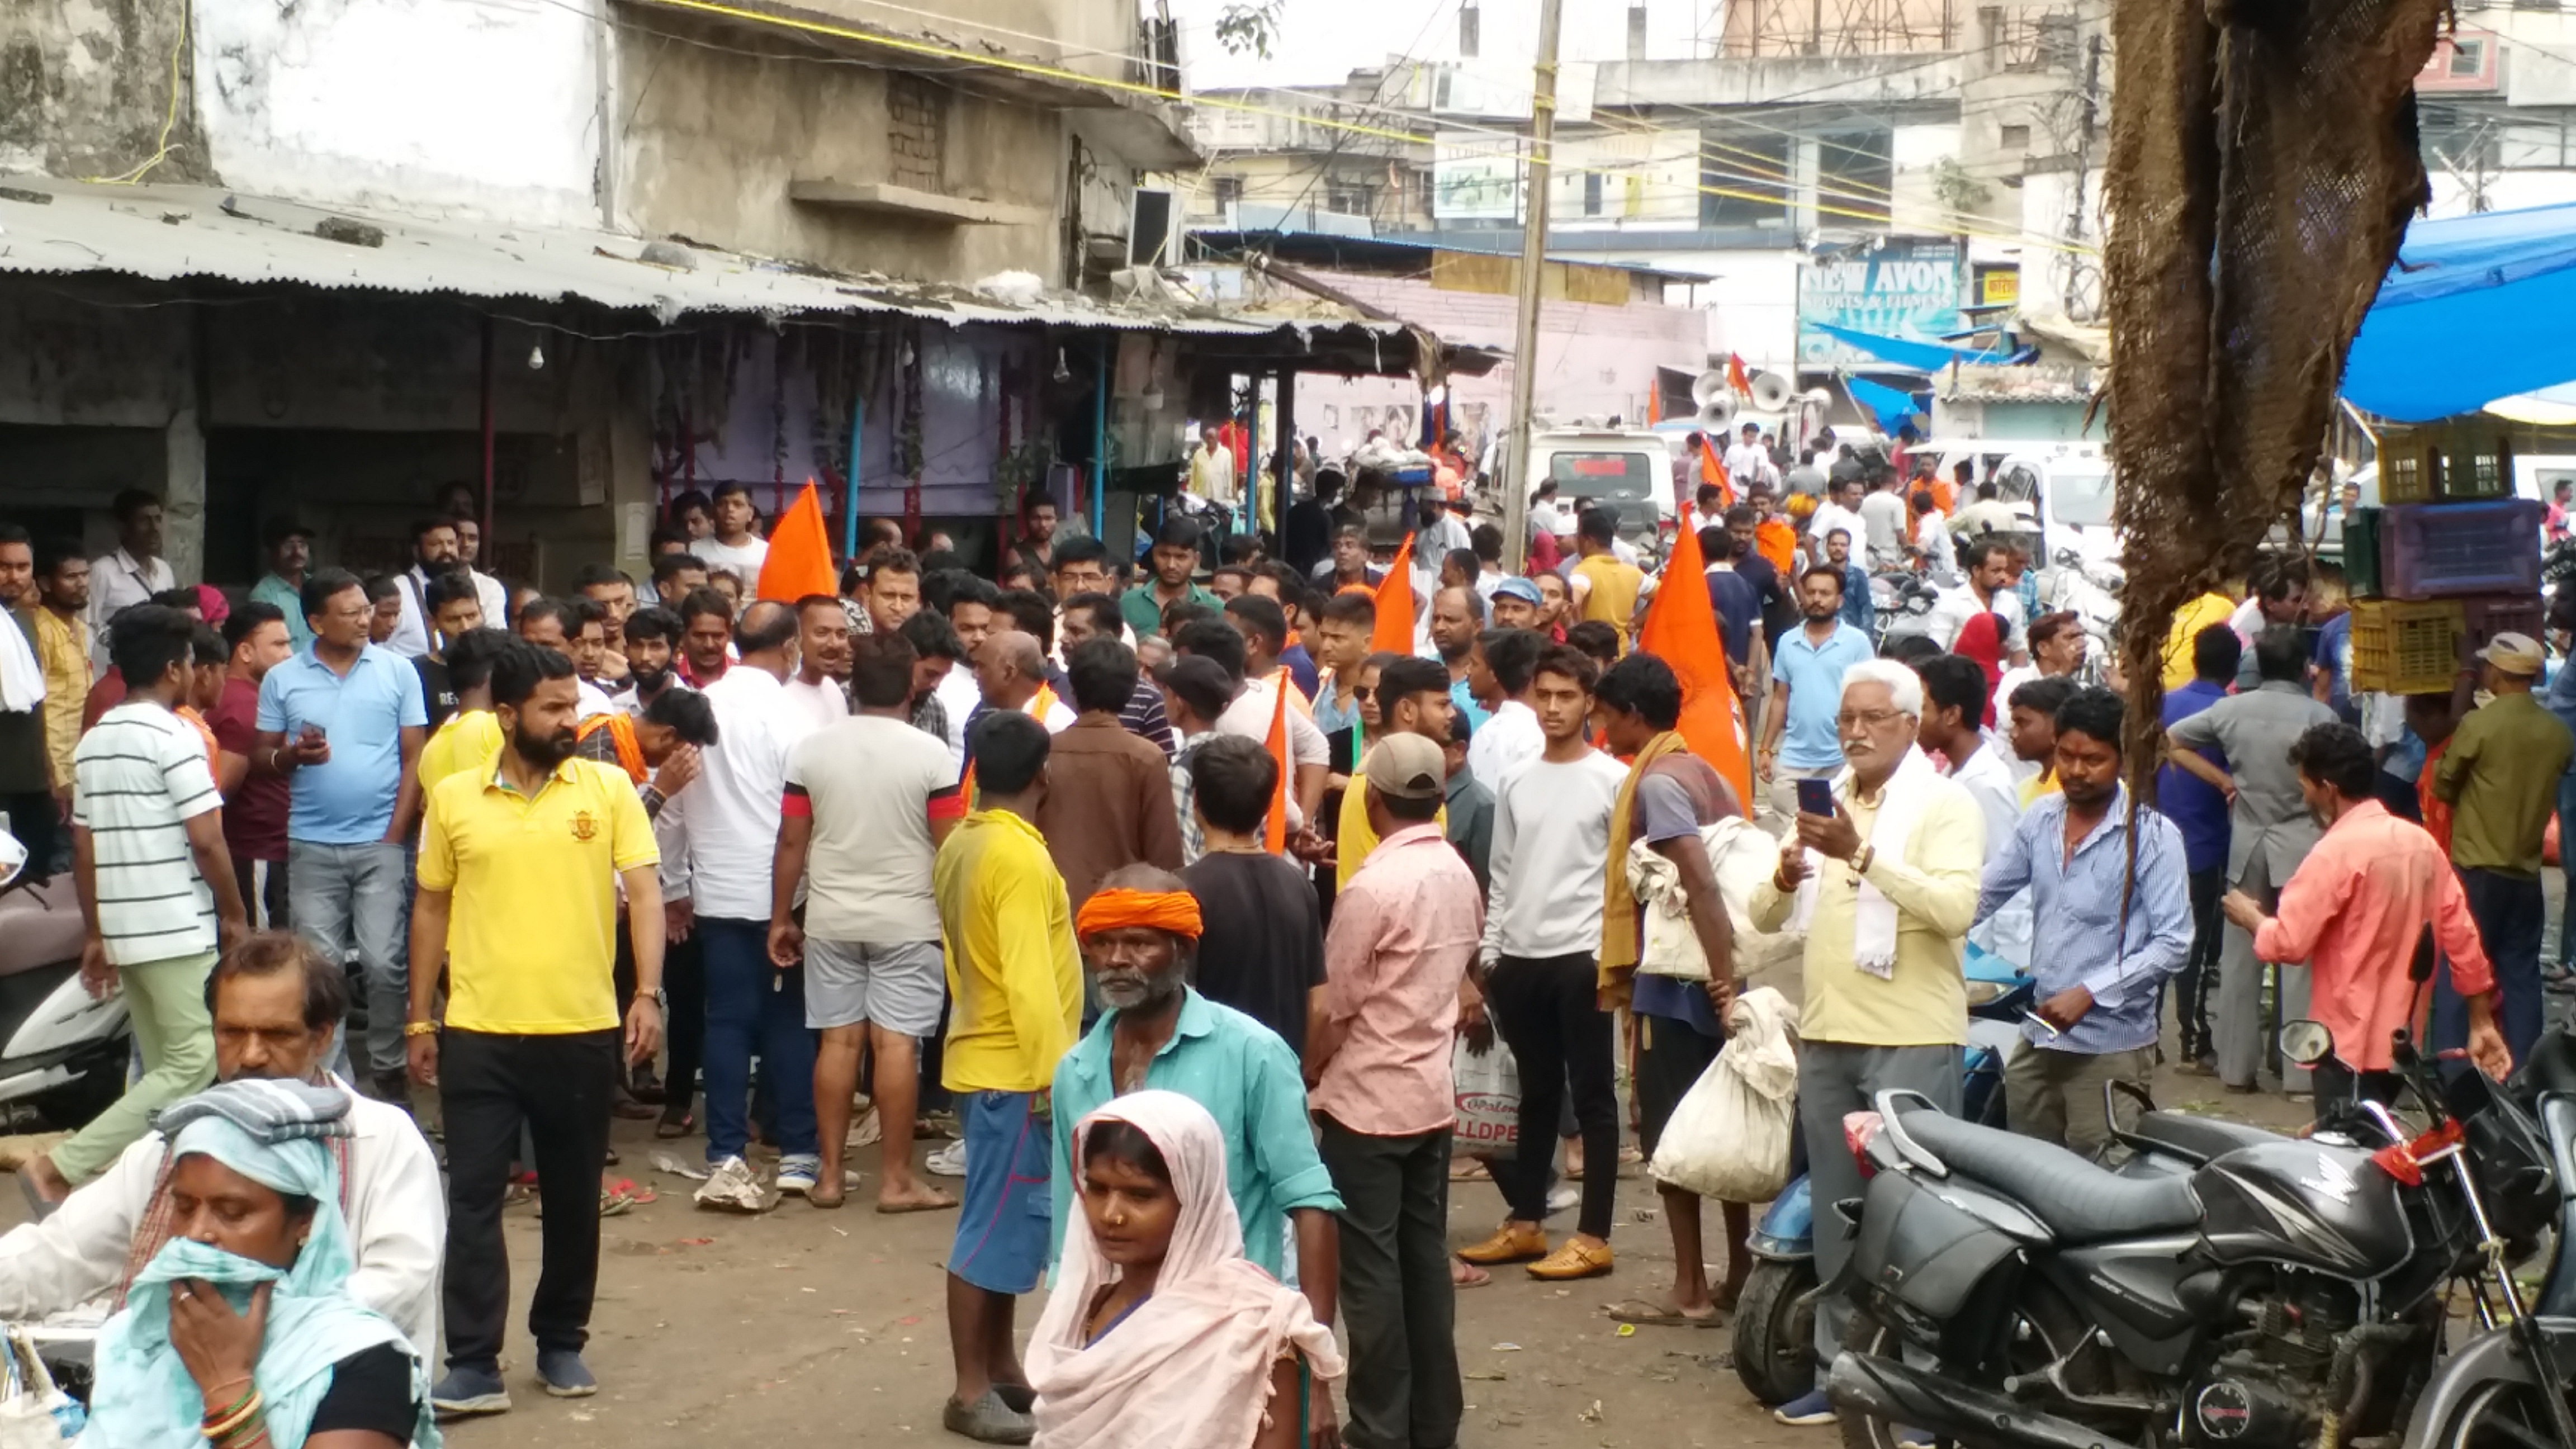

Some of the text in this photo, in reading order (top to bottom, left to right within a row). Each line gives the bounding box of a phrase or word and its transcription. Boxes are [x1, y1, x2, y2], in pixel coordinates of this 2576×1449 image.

[1802, 262, 1869, 292] NEW
[1873, 261, 1953, 293] AVON
[1867, 293, 1884, 307] &
[1452, 1119, 1518, 1142] LLDPE
